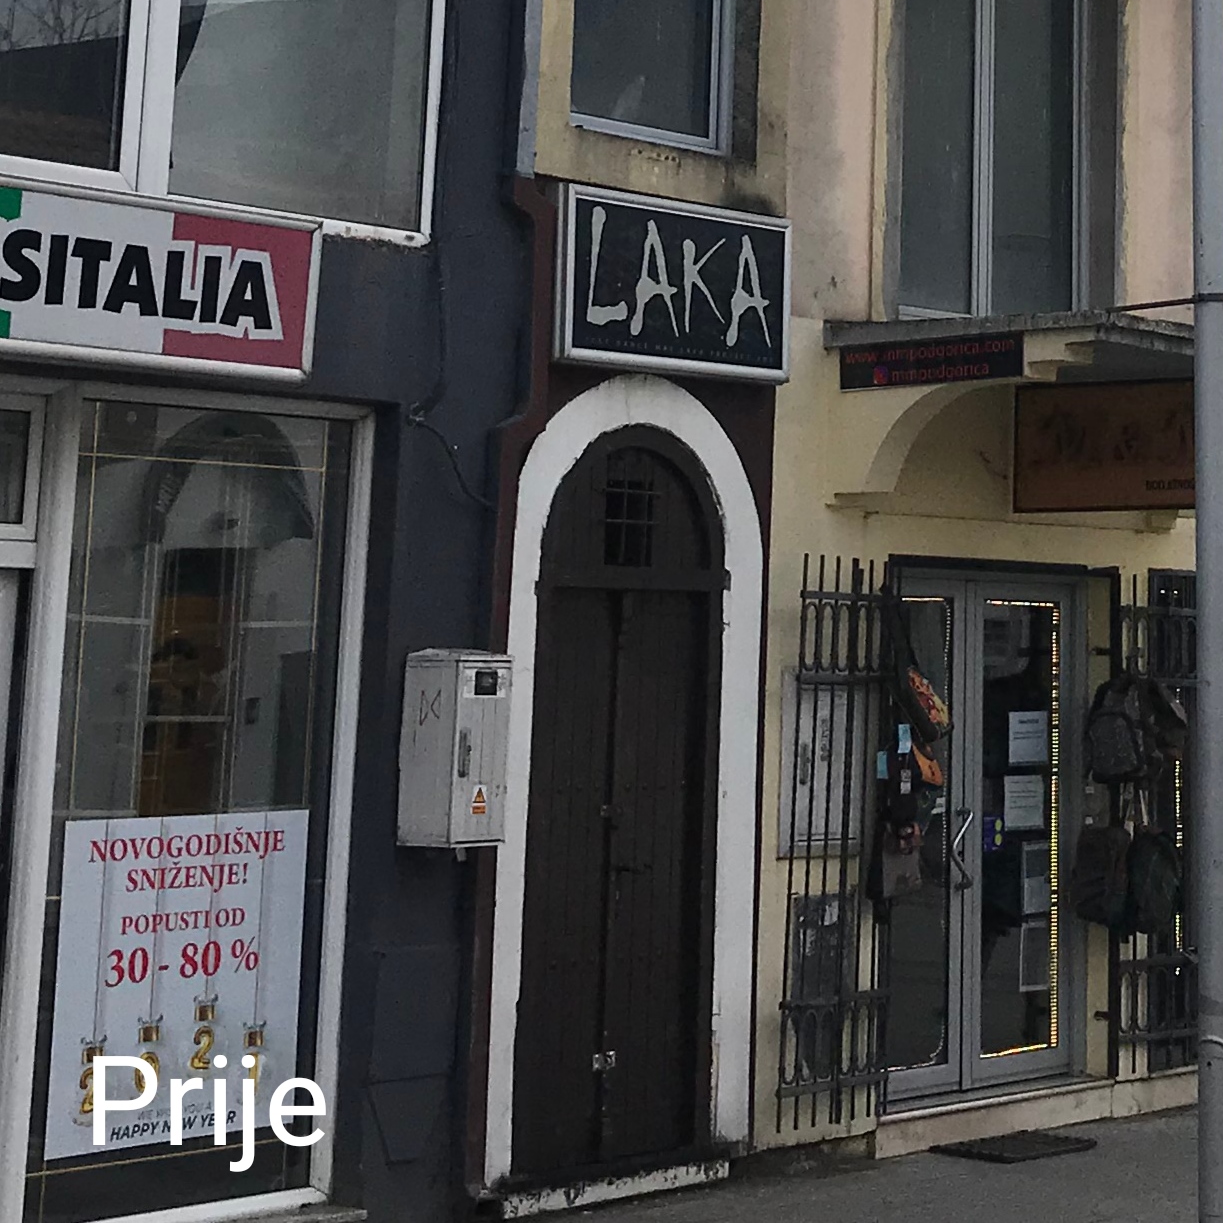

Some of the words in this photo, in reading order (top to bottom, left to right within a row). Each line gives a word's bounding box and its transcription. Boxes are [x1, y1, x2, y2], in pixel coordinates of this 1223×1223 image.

[0, 228, 273, 330] SITALIA
[586, 205, 772, 348] LAKA
[88, 826, 286, 864] NOVOGODIŠNJE
[125, 861, 249, 894] SNIŽENJE!
[119, 909, 210, 935] POPUSTI
[215, 907, 246, 928] OD
[104, 946, 149, 988] 30
[179, 940, 221, 980] 80
[230, 936, 260, 974] %
[110, 1119, 159, 1142] HAPPY
[162, 1113, 197, 1134] NW
[200, 1110, 237, 1129] YER
